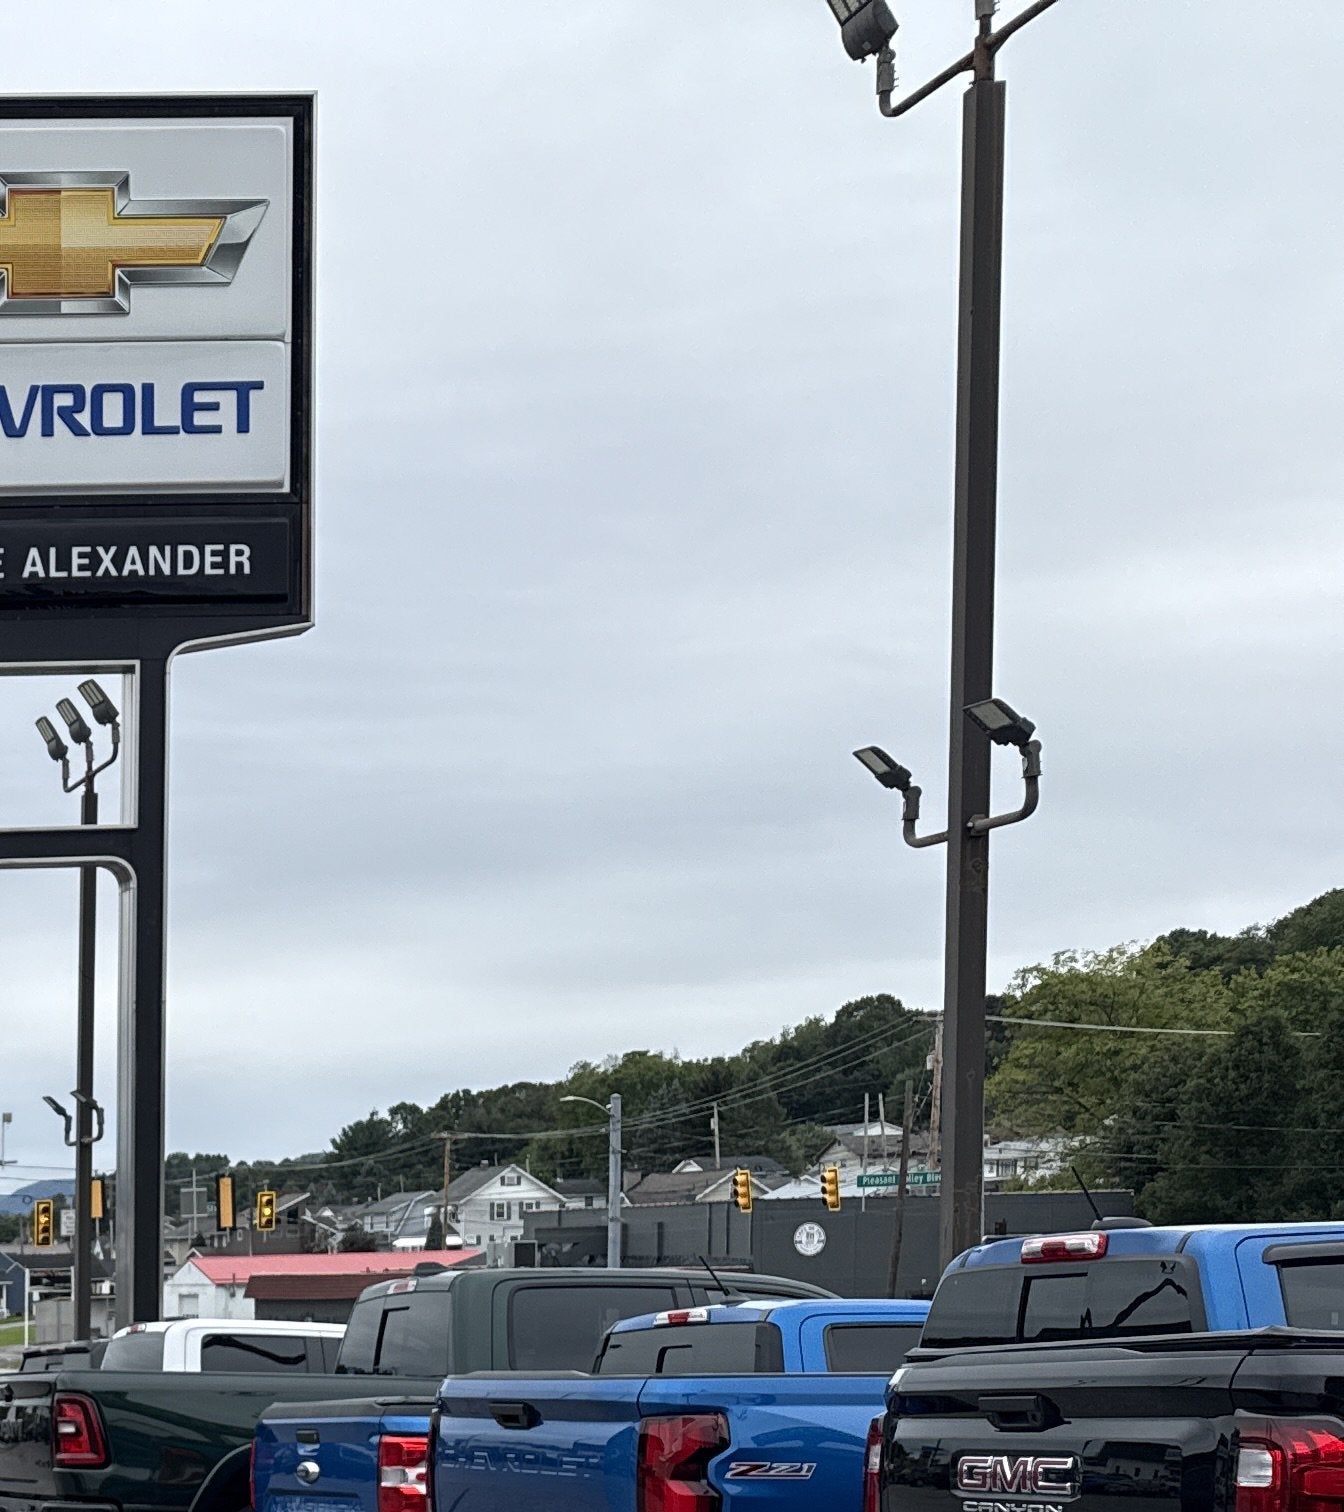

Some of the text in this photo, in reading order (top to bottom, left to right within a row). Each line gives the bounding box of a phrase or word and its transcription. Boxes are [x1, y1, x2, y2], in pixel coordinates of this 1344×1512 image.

[21, 543, 252, 579] ALEXANDER
[862, 1175, 896, 1185] Pleasant
[957, 1455, 1074, 1495] GMC
